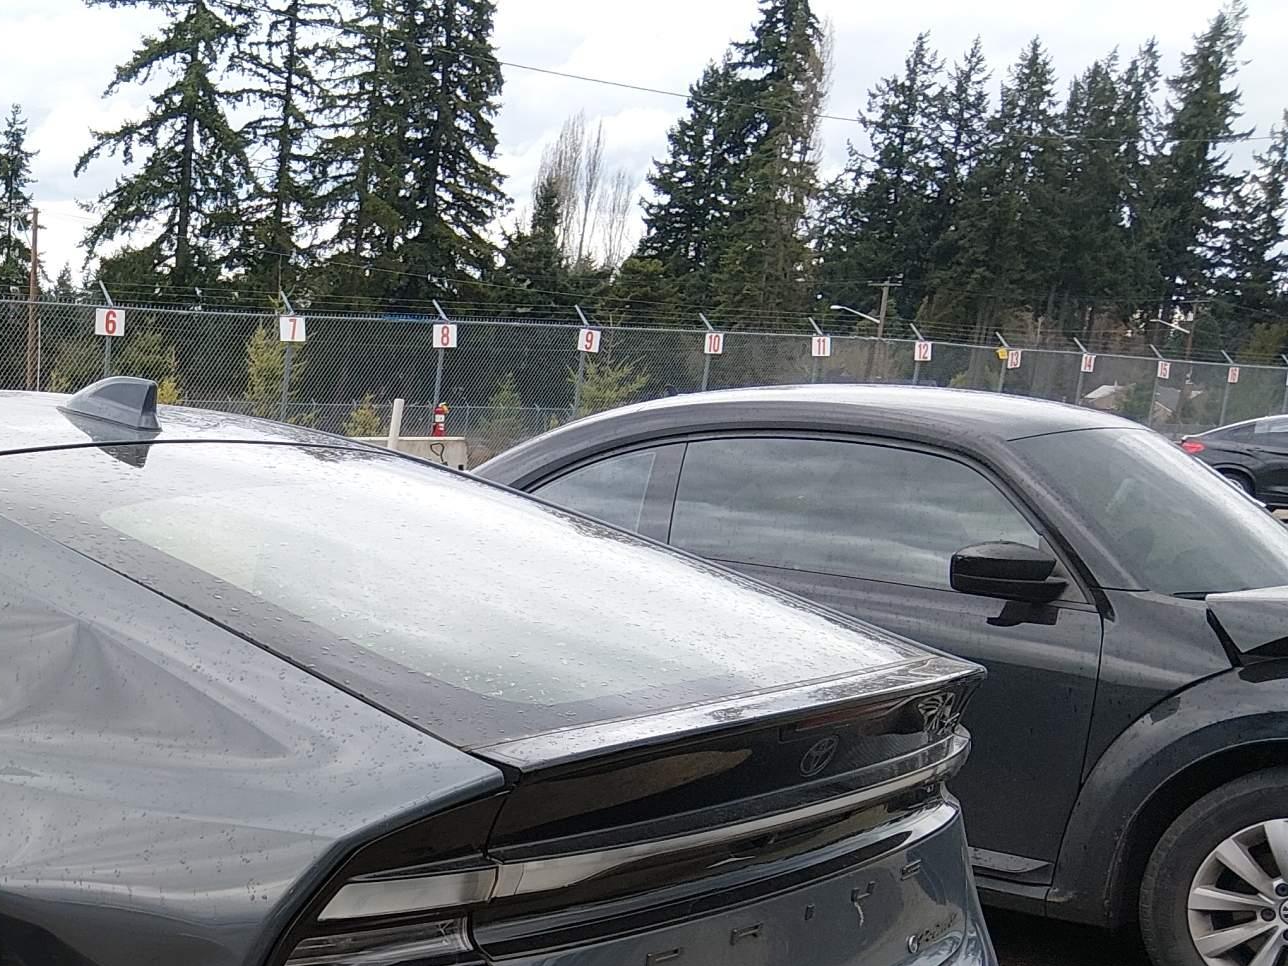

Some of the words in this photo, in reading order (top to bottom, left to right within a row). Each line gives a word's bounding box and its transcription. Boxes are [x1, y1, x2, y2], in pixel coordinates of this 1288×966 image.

[105, 310, 117, 335] 6
[288, 318, 297, 341] 7
[441, 325, 449, 346] 8
[584, 331, 594, 350] 9
[708, 334, 721, 353] 10
[816, 337, 826, 356] 11
[918, 343, 929, 360] 12
[1009, 351, 1020, 367] 13
[1159, 362, 1169, 377] 15
